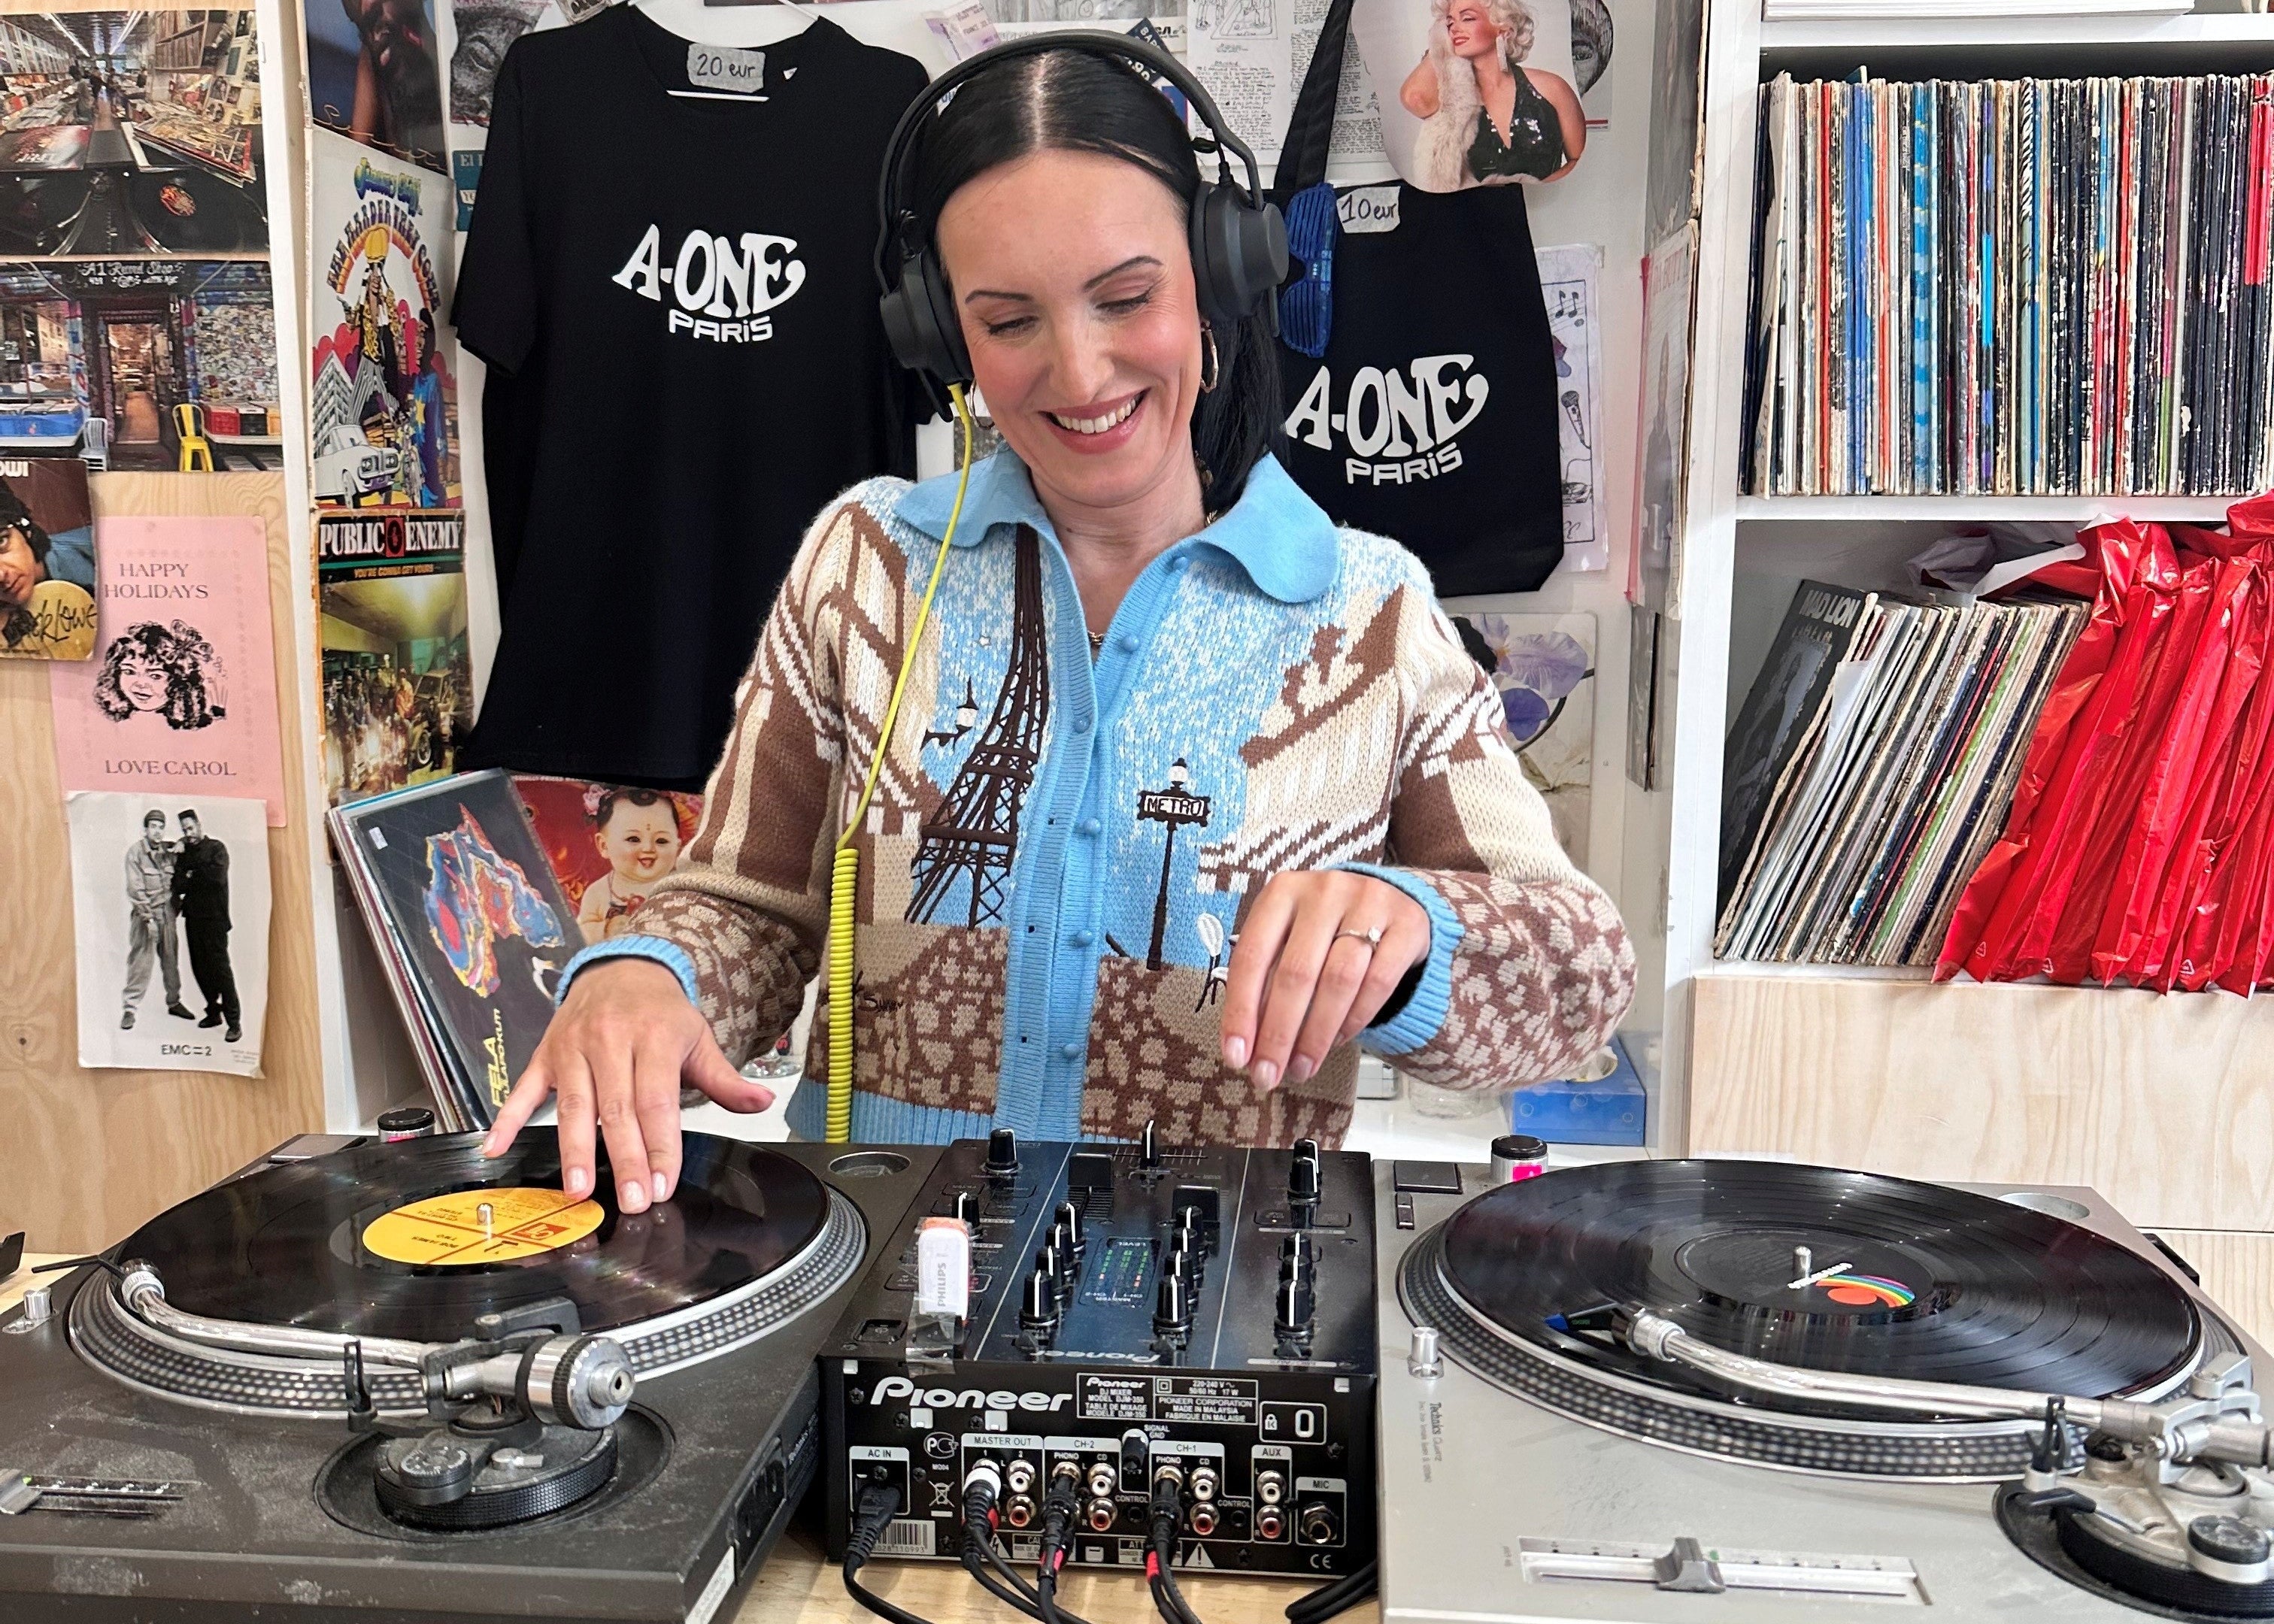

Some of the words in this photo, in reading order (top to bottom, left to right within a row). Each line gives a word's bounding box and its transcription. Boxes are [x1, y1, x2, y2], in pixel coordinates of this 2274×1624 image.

[697, 53, 723, 77] 20
[729, 62, 756, 78] eur
[344, 198, 391, 249] HARDER
[612, 223, 807, 318] A-ONE
[1284, 353, 1490, 457] A-ONE
[320, 522, 385, 556] PUBLIC
[405, 521, 463, 551] ENEMY
[120, 563, 189, 577] HAPPY
[105, 583, 208, 598] HOLIDAYS
[1823, 595, 1861, 629] LION
[105, 759, 161, 774] LOVE
[165, 760, 237, 776] CAROL
[1147, 798, 1202, 816] METRO
[937, 1262, 947, 1307] PHILIPS
[1087, 1377, 1146, 1389] Pioneer
[870, 1376, 1073, 1412] Pioneer
[1088, 1394, 1113, 1402] MODEL
[1110, 1388, 1132, 1396] MIXER
[1120, 1404, 1148, 1412] MIXAGE
[1159, 1397, 1193, 1405] PIONEER
[1195, 1398, 1253, 1407] CORPORATION
[1173, 1404, 1193, 1413] MADE
[1202, 1405, 1239, 1414] MALAYSIA
[1165, 1411, 1201, 1420] FABRIQUE
[1202, 1413, 1212, 1421] EN
[1213, 1413, 1246, 1423] MALAISIE
[1144, 1425, 1170, 1433] SIGNAL
[975, 1437, 1011, 1445] MASTER
[1014, 1438, 1031, 1446] OUT
[1074, 1440, 1095, 1448] CH-2
[868, 1450, 881, 1458] AC
[883, 1450, 891, 1458] IN
[1176, 1444, 1197, 1453] CH-1
[1262, 1448, 1281, 1456] AUX
[1313, 1480, 1330, 1489] MIC
[1217, 1499, 1251, 1507] CONTROL
